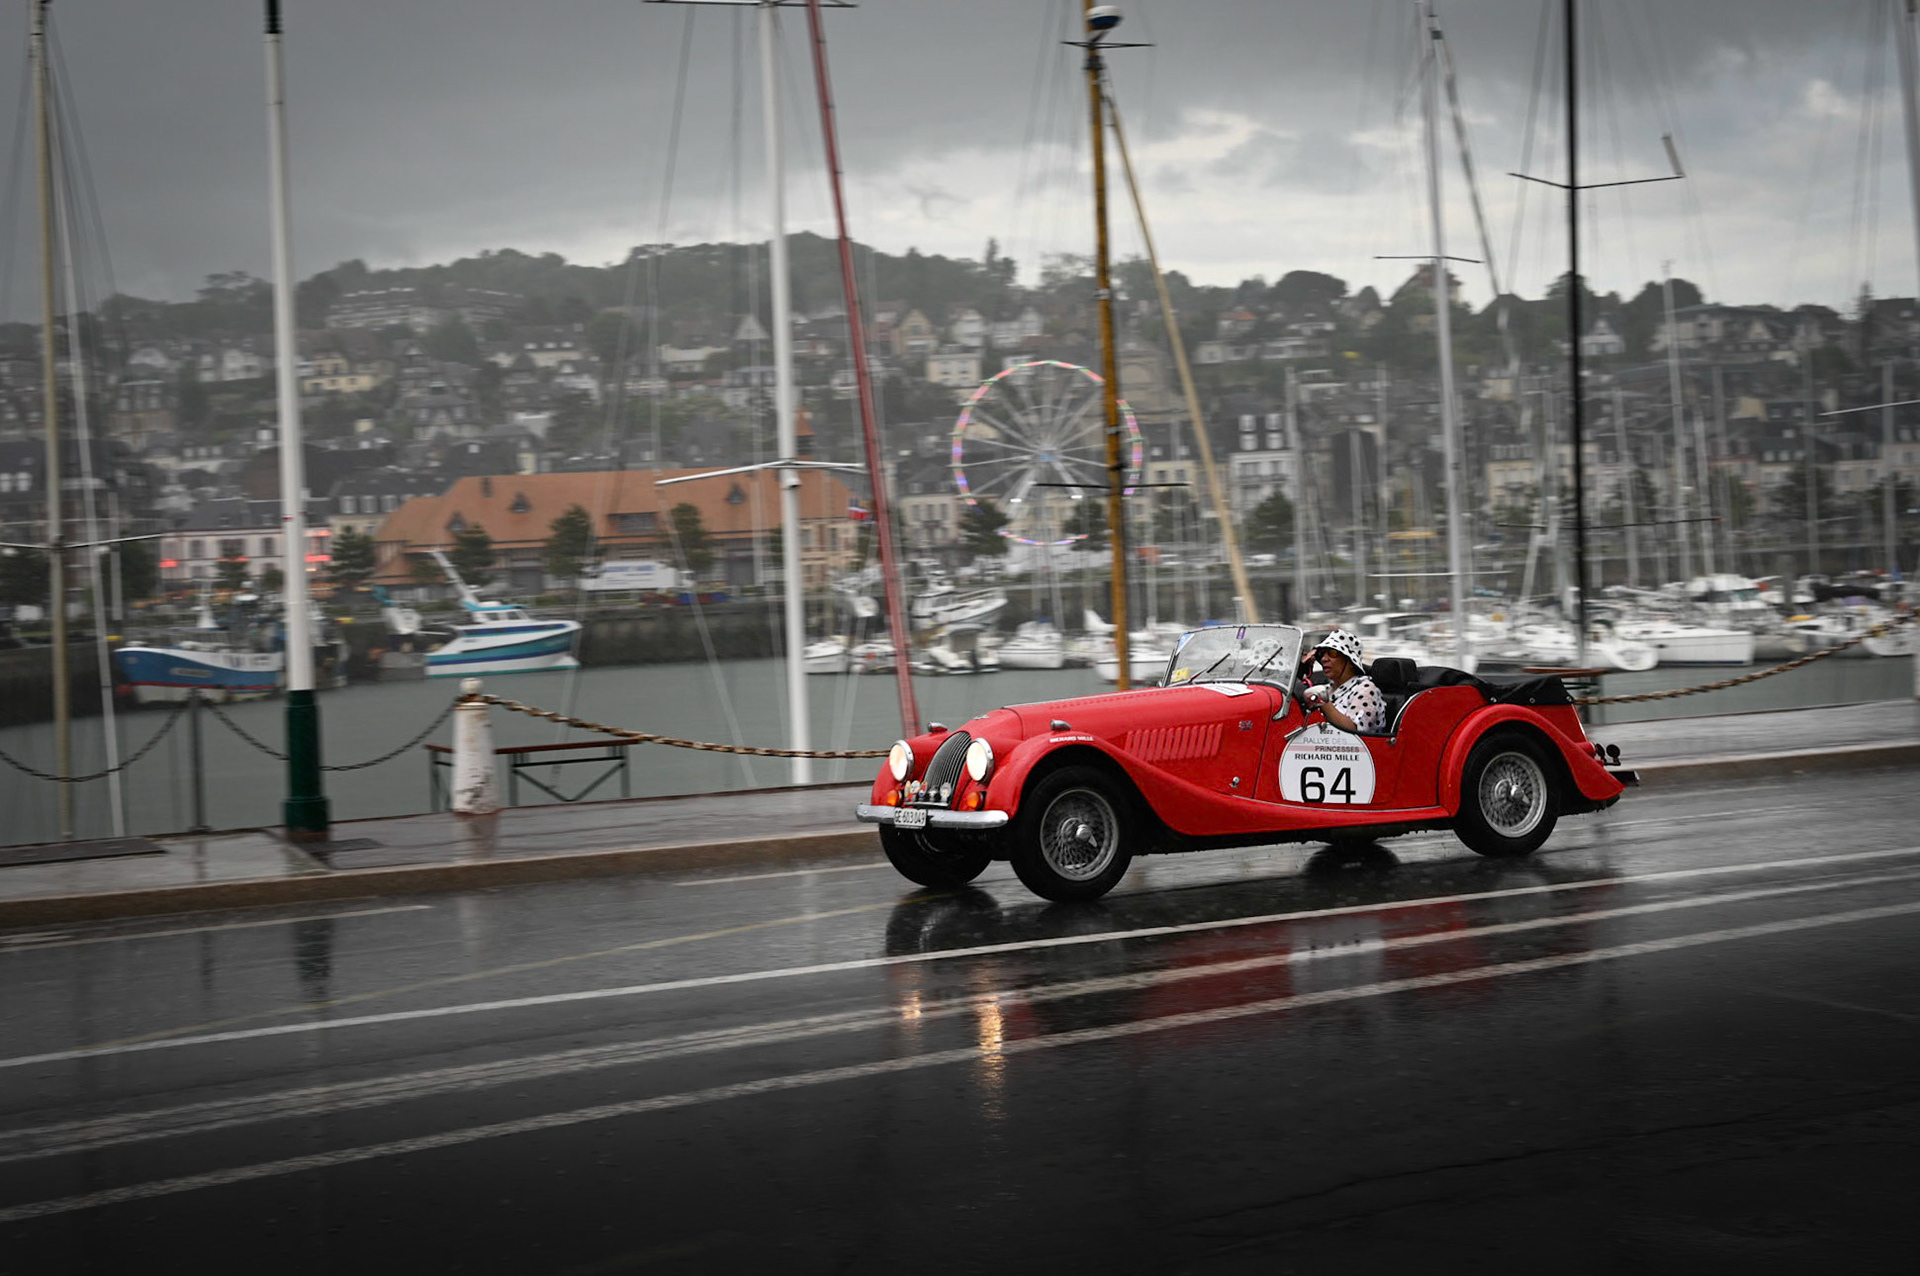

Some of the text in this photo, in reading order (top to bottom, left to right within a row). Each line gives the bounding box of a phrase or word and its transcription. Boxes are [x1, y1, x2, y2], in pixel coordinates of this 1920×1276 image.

[1303, 737, 1330, 745] RALLYE
[1315, 745, 1360, 753] PRINCESSES
[1295, 753, 1360, 762] RICHARD MILLE
[1301, 766, 1356, 804] 64
